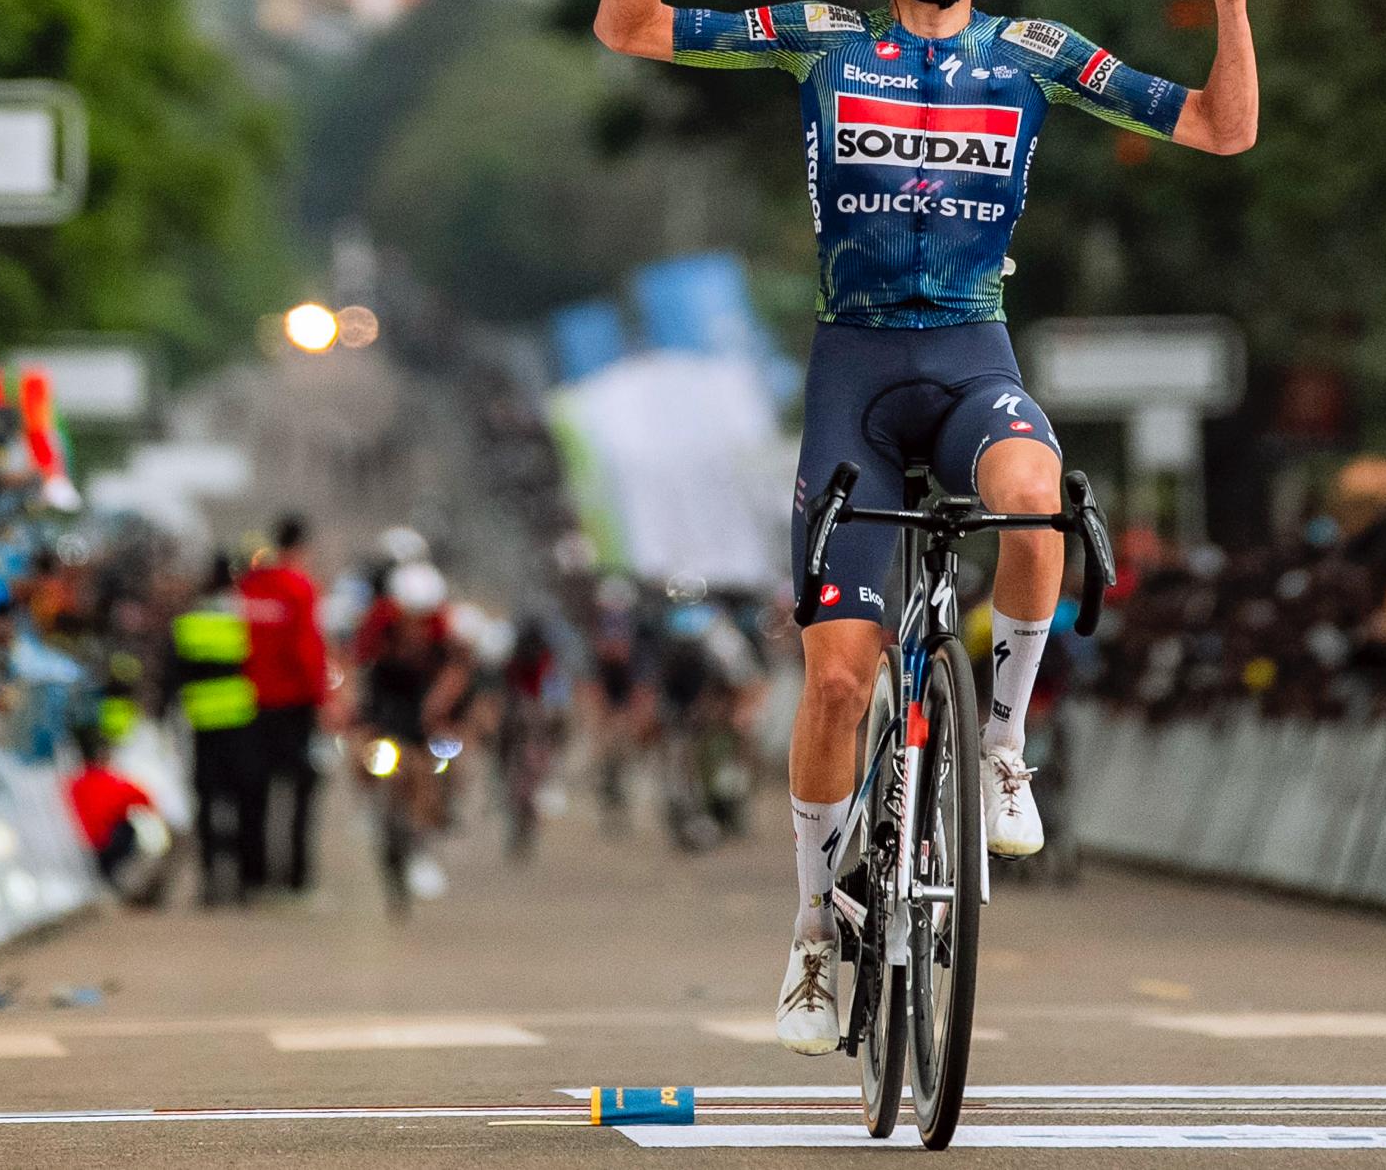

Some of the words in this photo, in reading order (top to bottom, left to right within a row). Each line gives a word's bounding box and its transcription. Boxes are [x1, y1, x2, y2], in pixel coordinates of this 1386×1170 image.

[1024, 30, 1060, 49] JOGGER
[1028, 22, 1064, 40] SAFETY
[843, 63, 919, 90] Ekopak
[837, 129, 1011, 170] SOUDAL
[807, 121, 822, 234] SOUDAL
